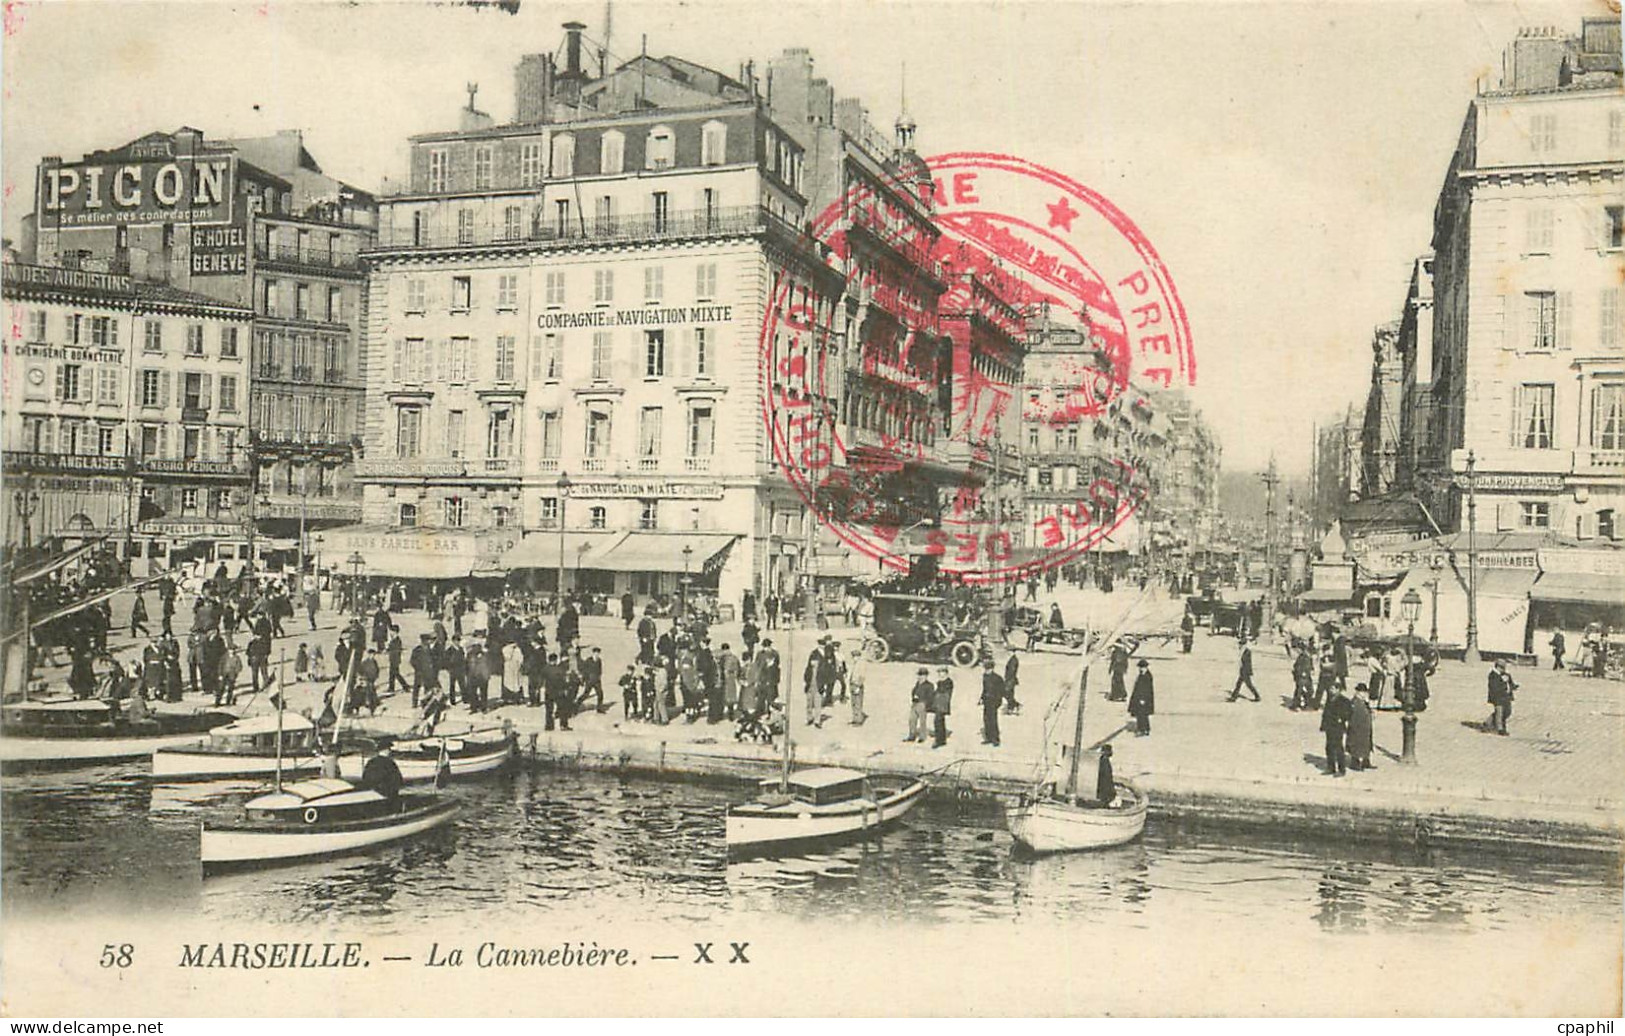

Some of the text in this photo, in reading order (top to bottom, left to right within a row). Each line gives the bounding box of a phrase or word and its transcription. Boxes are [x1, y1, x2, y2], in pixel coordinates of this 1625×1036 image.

[47, 162, 227, 210] PICON
[60, 214, 74, 225] Se
[116, 209, 136, 223] des
[22, 266, 50, 283] DES
[54, 270, 131, 292] AUGUSTINS
[538, 312, 606, 329] COMPAGNIE
[617, 308, 687, 326] NAVIGATION
[691, 306, 733, 322] MIXTE
[59, 455, 126, 470] ANGLAISES
[591, 483, 645, 495] NAVIGATION
[648, 484, 677, 495] MIXTE
[433, 538, 459, 550] BAR
